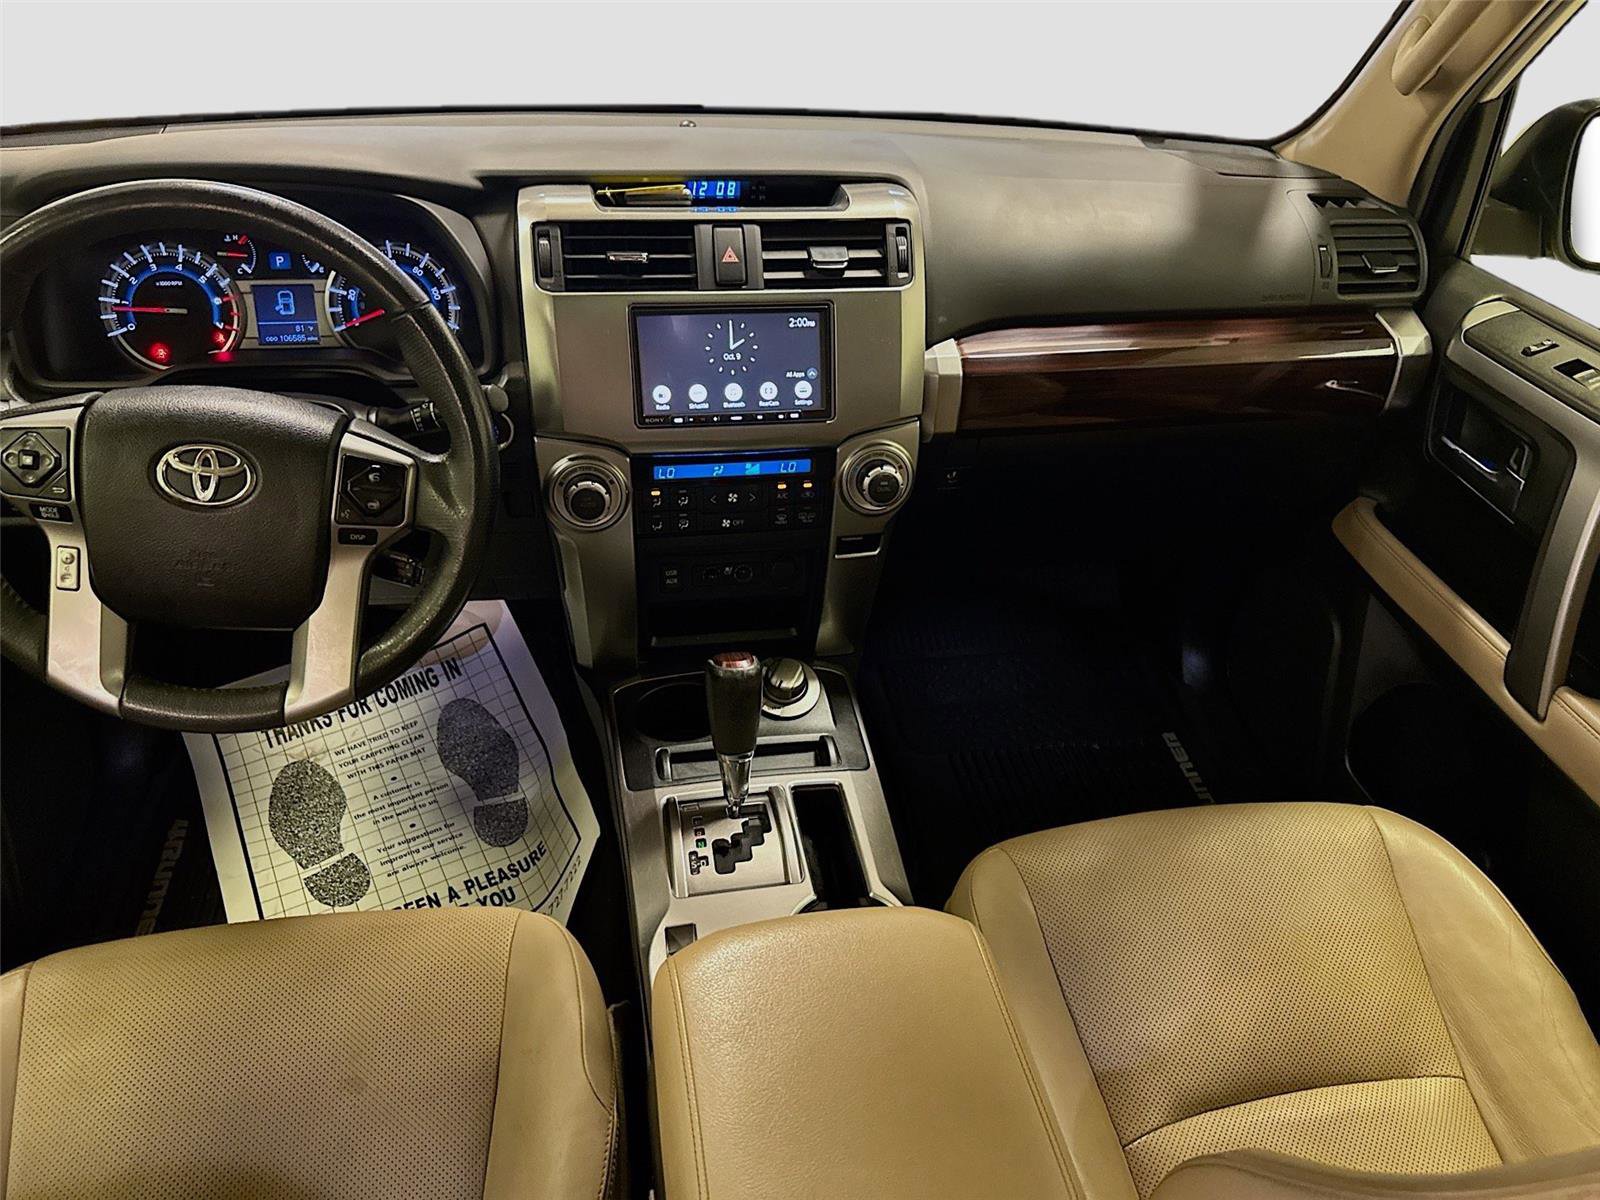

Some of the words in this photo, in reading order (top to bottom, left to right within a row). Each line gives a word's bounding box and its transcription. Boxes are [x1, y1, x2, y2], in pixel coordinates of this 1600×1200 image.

[149, 264, 157, 272] 3
[175, 263, 183, 271] 4
[275, 256, 284, 267] P
[237, 267, 244, 275] C
[412, 266, 424, 276] 80
[129, 276, 138, 285] 2
[198, 275, 208, 284] 5
[347, 288, 356, 301] 20
[431, 286, 441, 301] 100
[127, 322, 137, 332] 0
[735, 352, 742, 361] 9
[261, 713, 334, 749] THANKS
[337, 697, 373, 723] FOR
[374, 668, 440, 709] COMING
[440, 656, 464, 682] IN
[334, 748, 346, 757] WE
[347, 741, 367, 752] HAVE
[368, 731, 389, 744] TRIED
[390, 727, 401, 736] TO
[401, 720, 419, 732] KEEP
[338, 758, 359, 769] YOUR
[360, 743, 400, 761] CARPETING
[402, 733, 425, 746] CLEAN
[347, 768, 367, 780] WITH
[368, 762, 385, 772] THIS
[386, 754, 409, 766] PAPER
[410, 747, 427, 757] MAT
[380, 784, 413, 798] customer
[354, 811, 366, 820] the
[367, 804, 386, 815] most
[387, 792, 423, 808] important
[424, 782, 449, 796] person
[381, 813, 395, 822] the
[396, 805, 417, 817] world
[376, 843, 396, 854] Your
[398, 826, 443, 847] suggestions
[444, 821, 456, 829] for
[379, 845, 421, 867] improving
[421, 842, 435, 851] our
[437, 831, 463, 846] service
[386, 869, 400, 878] are
[401, 858, 429, 873] always
[393, 892, 442, 910] EEN
[447, 885, 462, 904] A
[463, 840, 548, 896] PLEASURE
[475, 885, 517, 907] YOU
